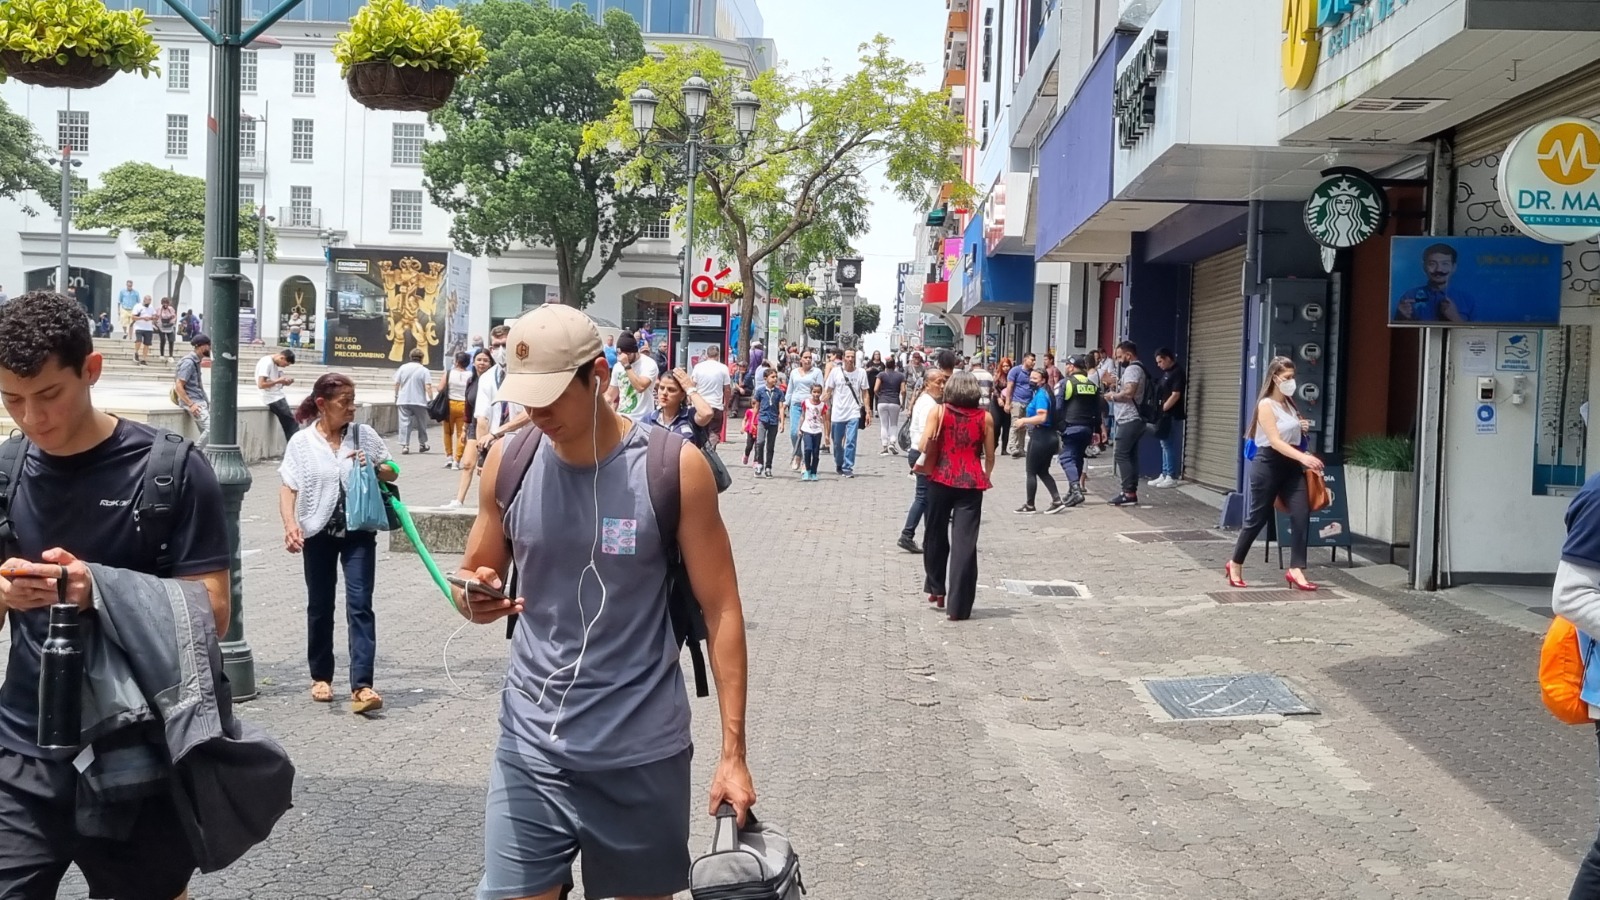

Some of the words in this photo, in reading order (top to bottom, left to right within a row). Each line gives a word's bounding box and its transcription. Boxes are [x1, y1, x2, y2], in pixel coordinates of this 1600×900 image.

[1328, 7, 1374, 59] CENTRO
[1518, 189, 1556, 210] DR.
[1523, 216, 1560, 224] CENTRO
[334, 351, 385, 359] PRECOLOMBINO
